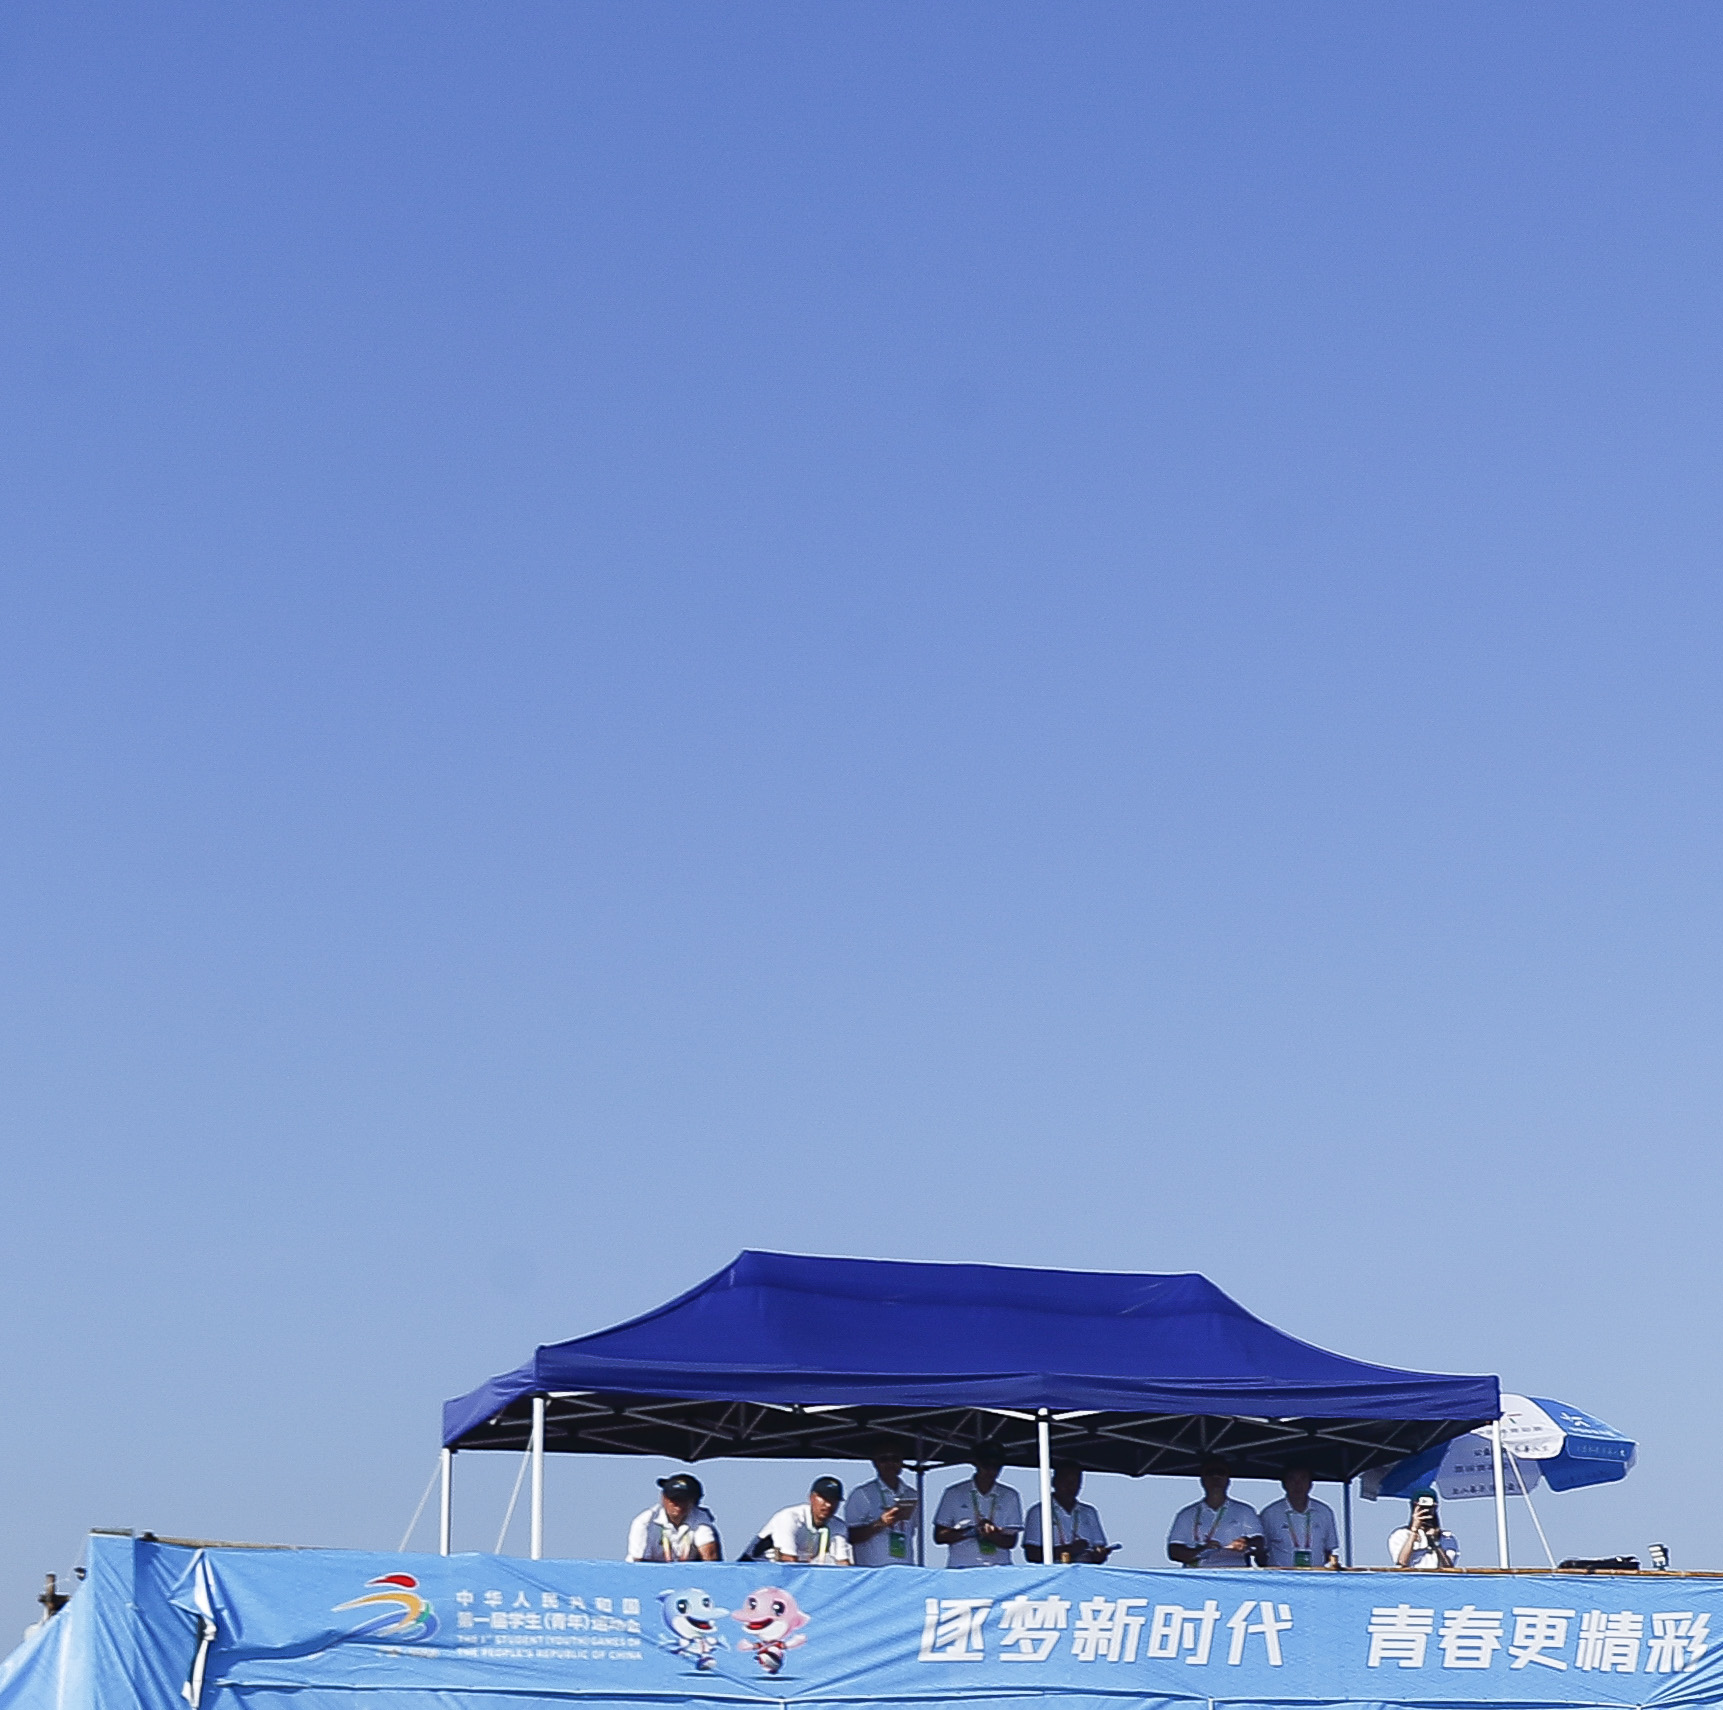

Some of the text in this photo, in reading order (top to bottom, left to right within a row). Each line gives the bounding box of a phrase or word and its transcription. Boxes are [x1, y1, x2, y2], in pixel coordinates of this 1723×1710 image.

[917, 1595, 1710, 1674] 逐梦新时代 青春更精彩
